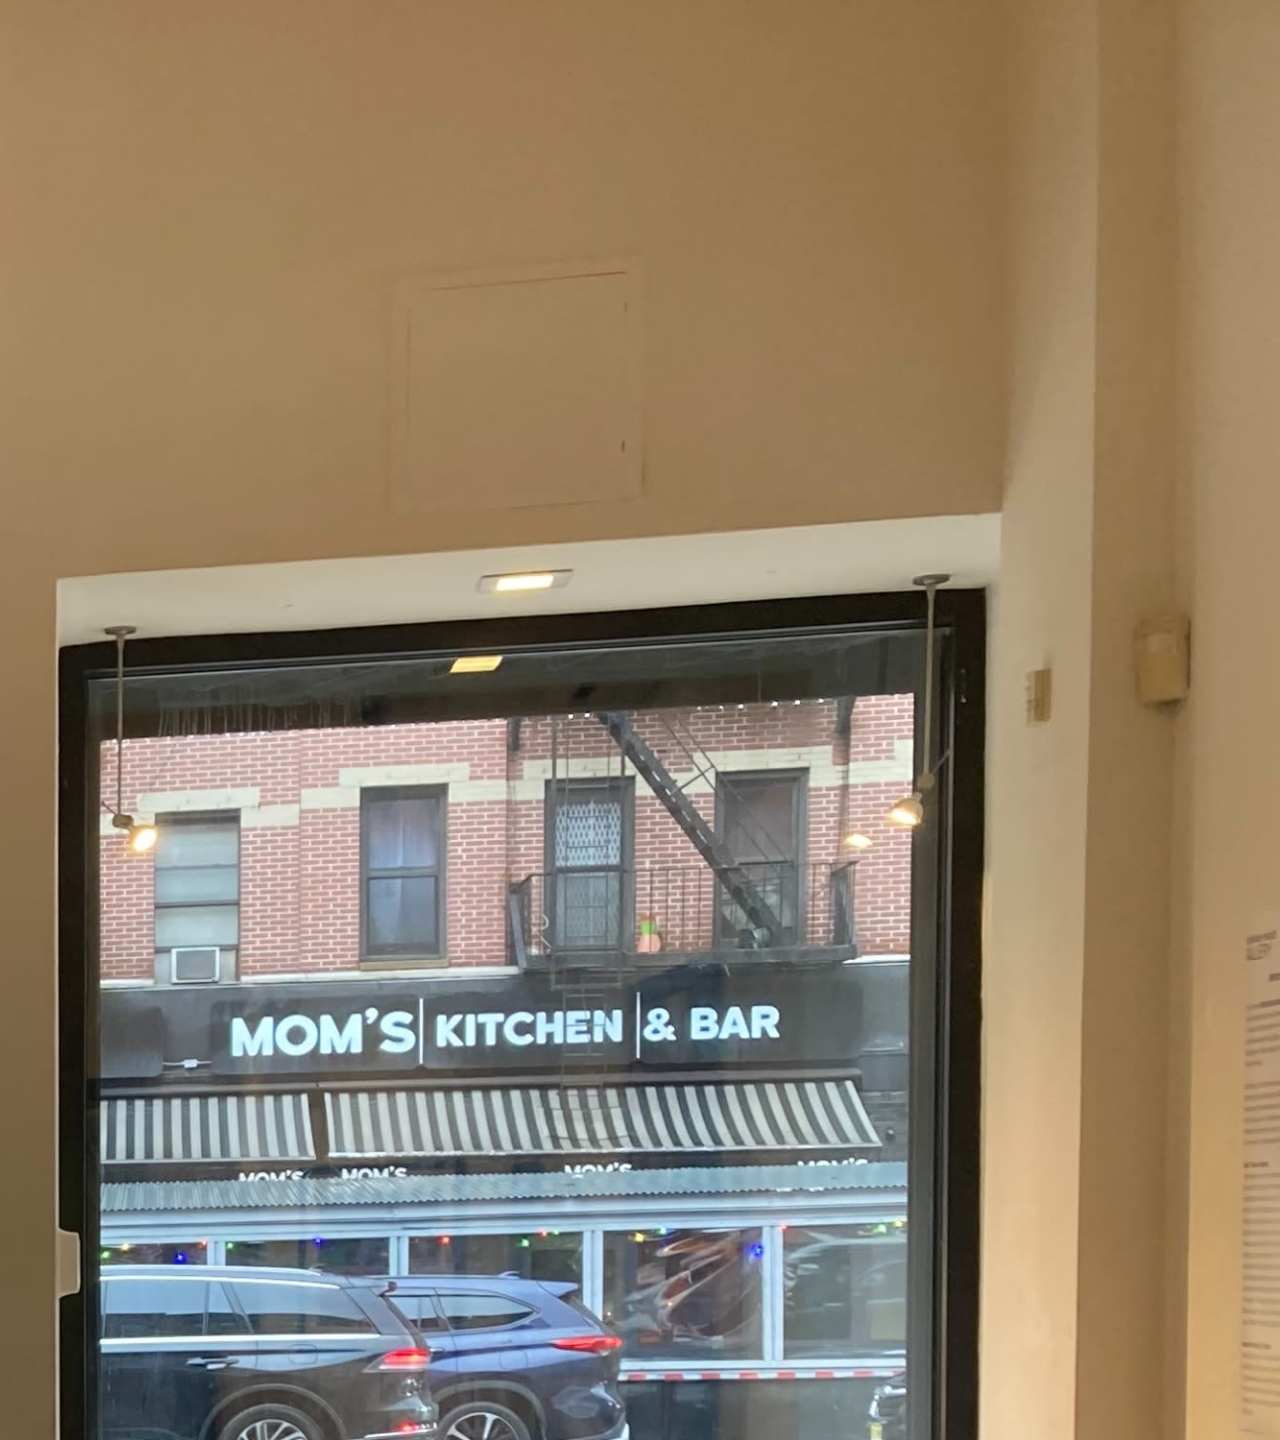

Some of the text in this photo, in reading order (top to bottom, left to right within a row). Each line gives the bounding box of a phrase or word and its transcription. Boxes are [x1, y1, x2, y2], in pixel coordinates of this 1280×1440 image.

[231, 1005, 781, 1057] MOM'S KITCHEN & BAR
